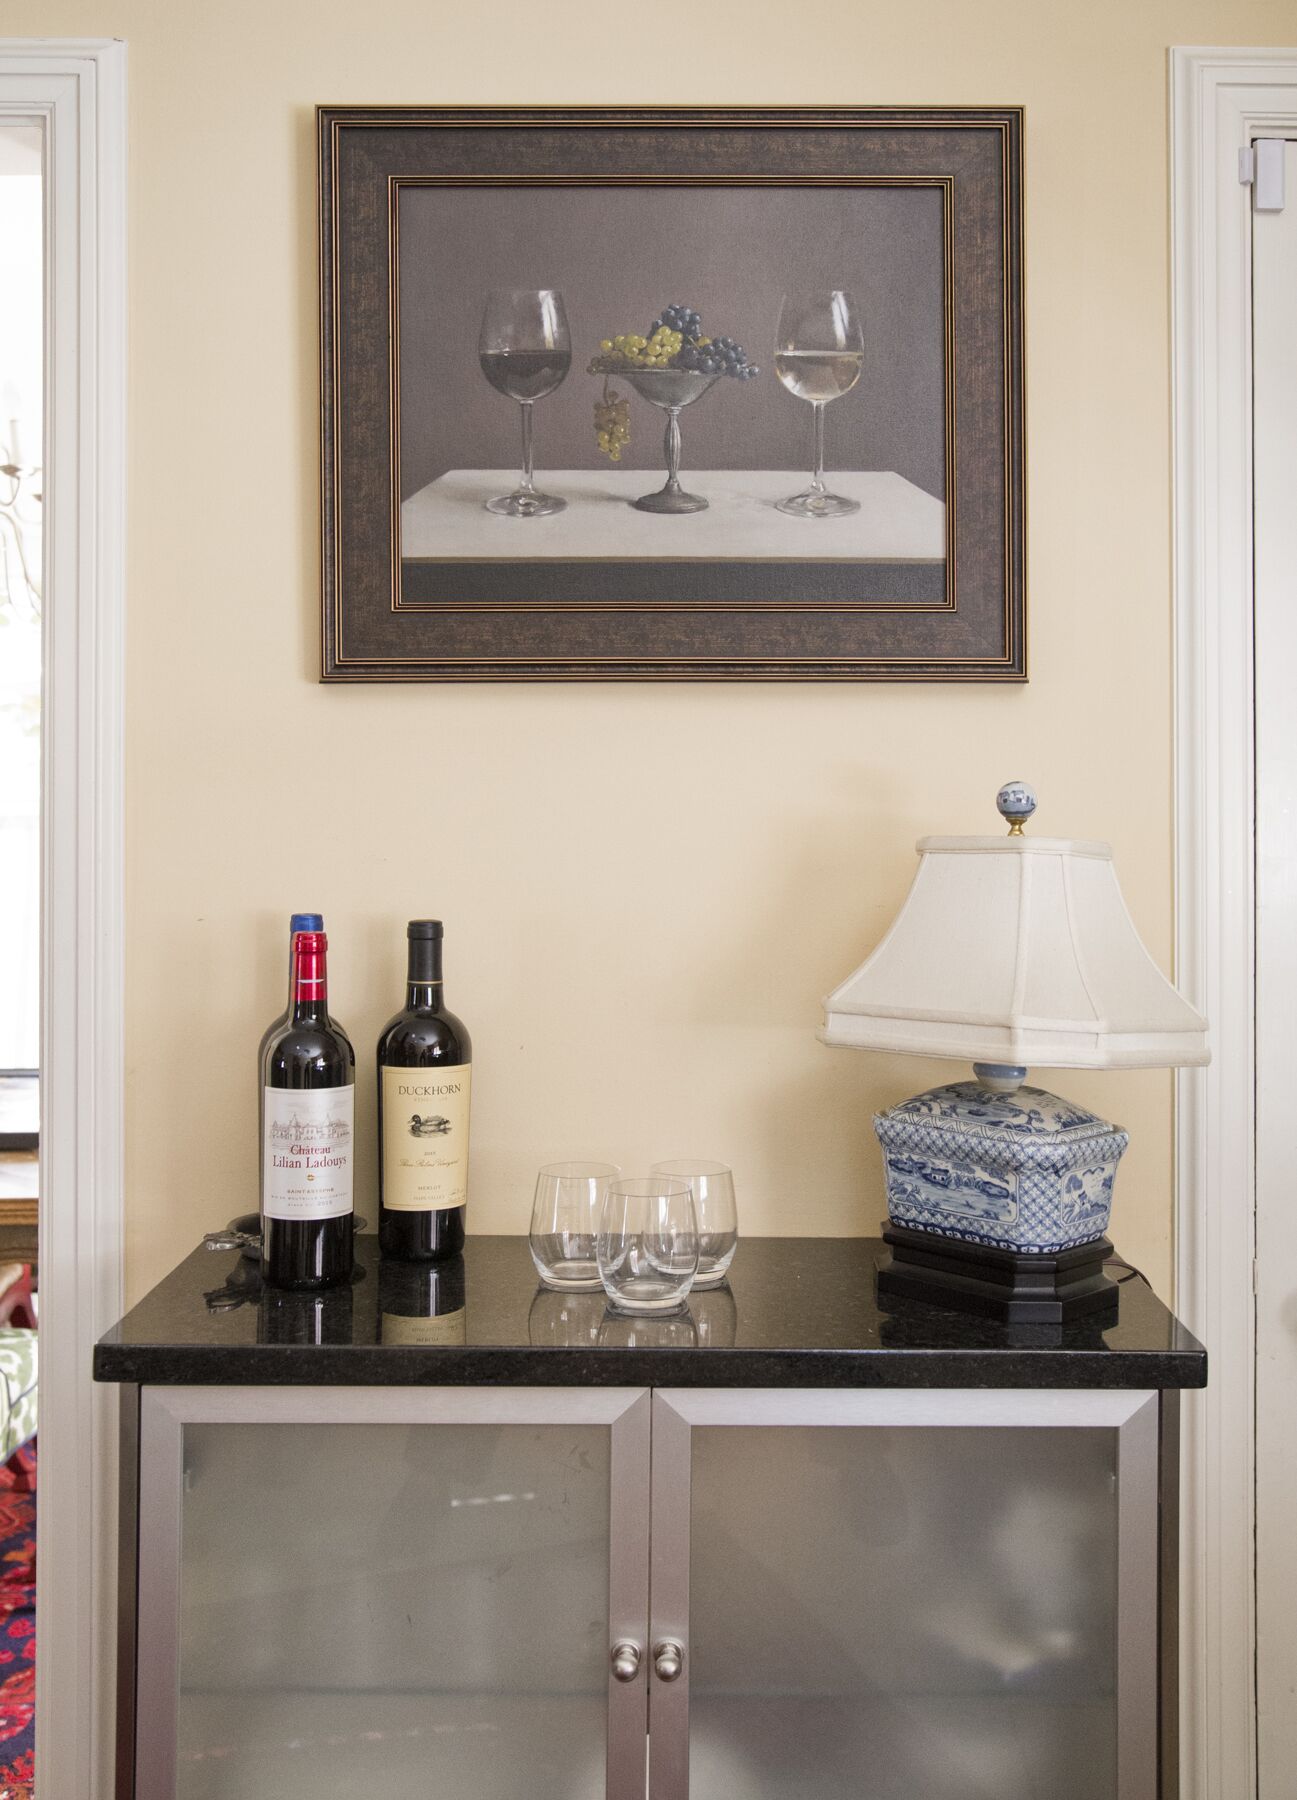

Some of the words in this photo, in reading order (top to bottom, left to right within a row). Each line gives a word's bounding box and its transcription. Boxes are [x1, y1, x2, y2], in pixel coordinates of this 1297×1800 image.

[398, 1083, 461, 1096] DUCKHORN
[290, 1144, 332, 1155] Château
[273, 1155, 301, 1168] Lilian
[306, 1155, 347, 1168] Ladouys
